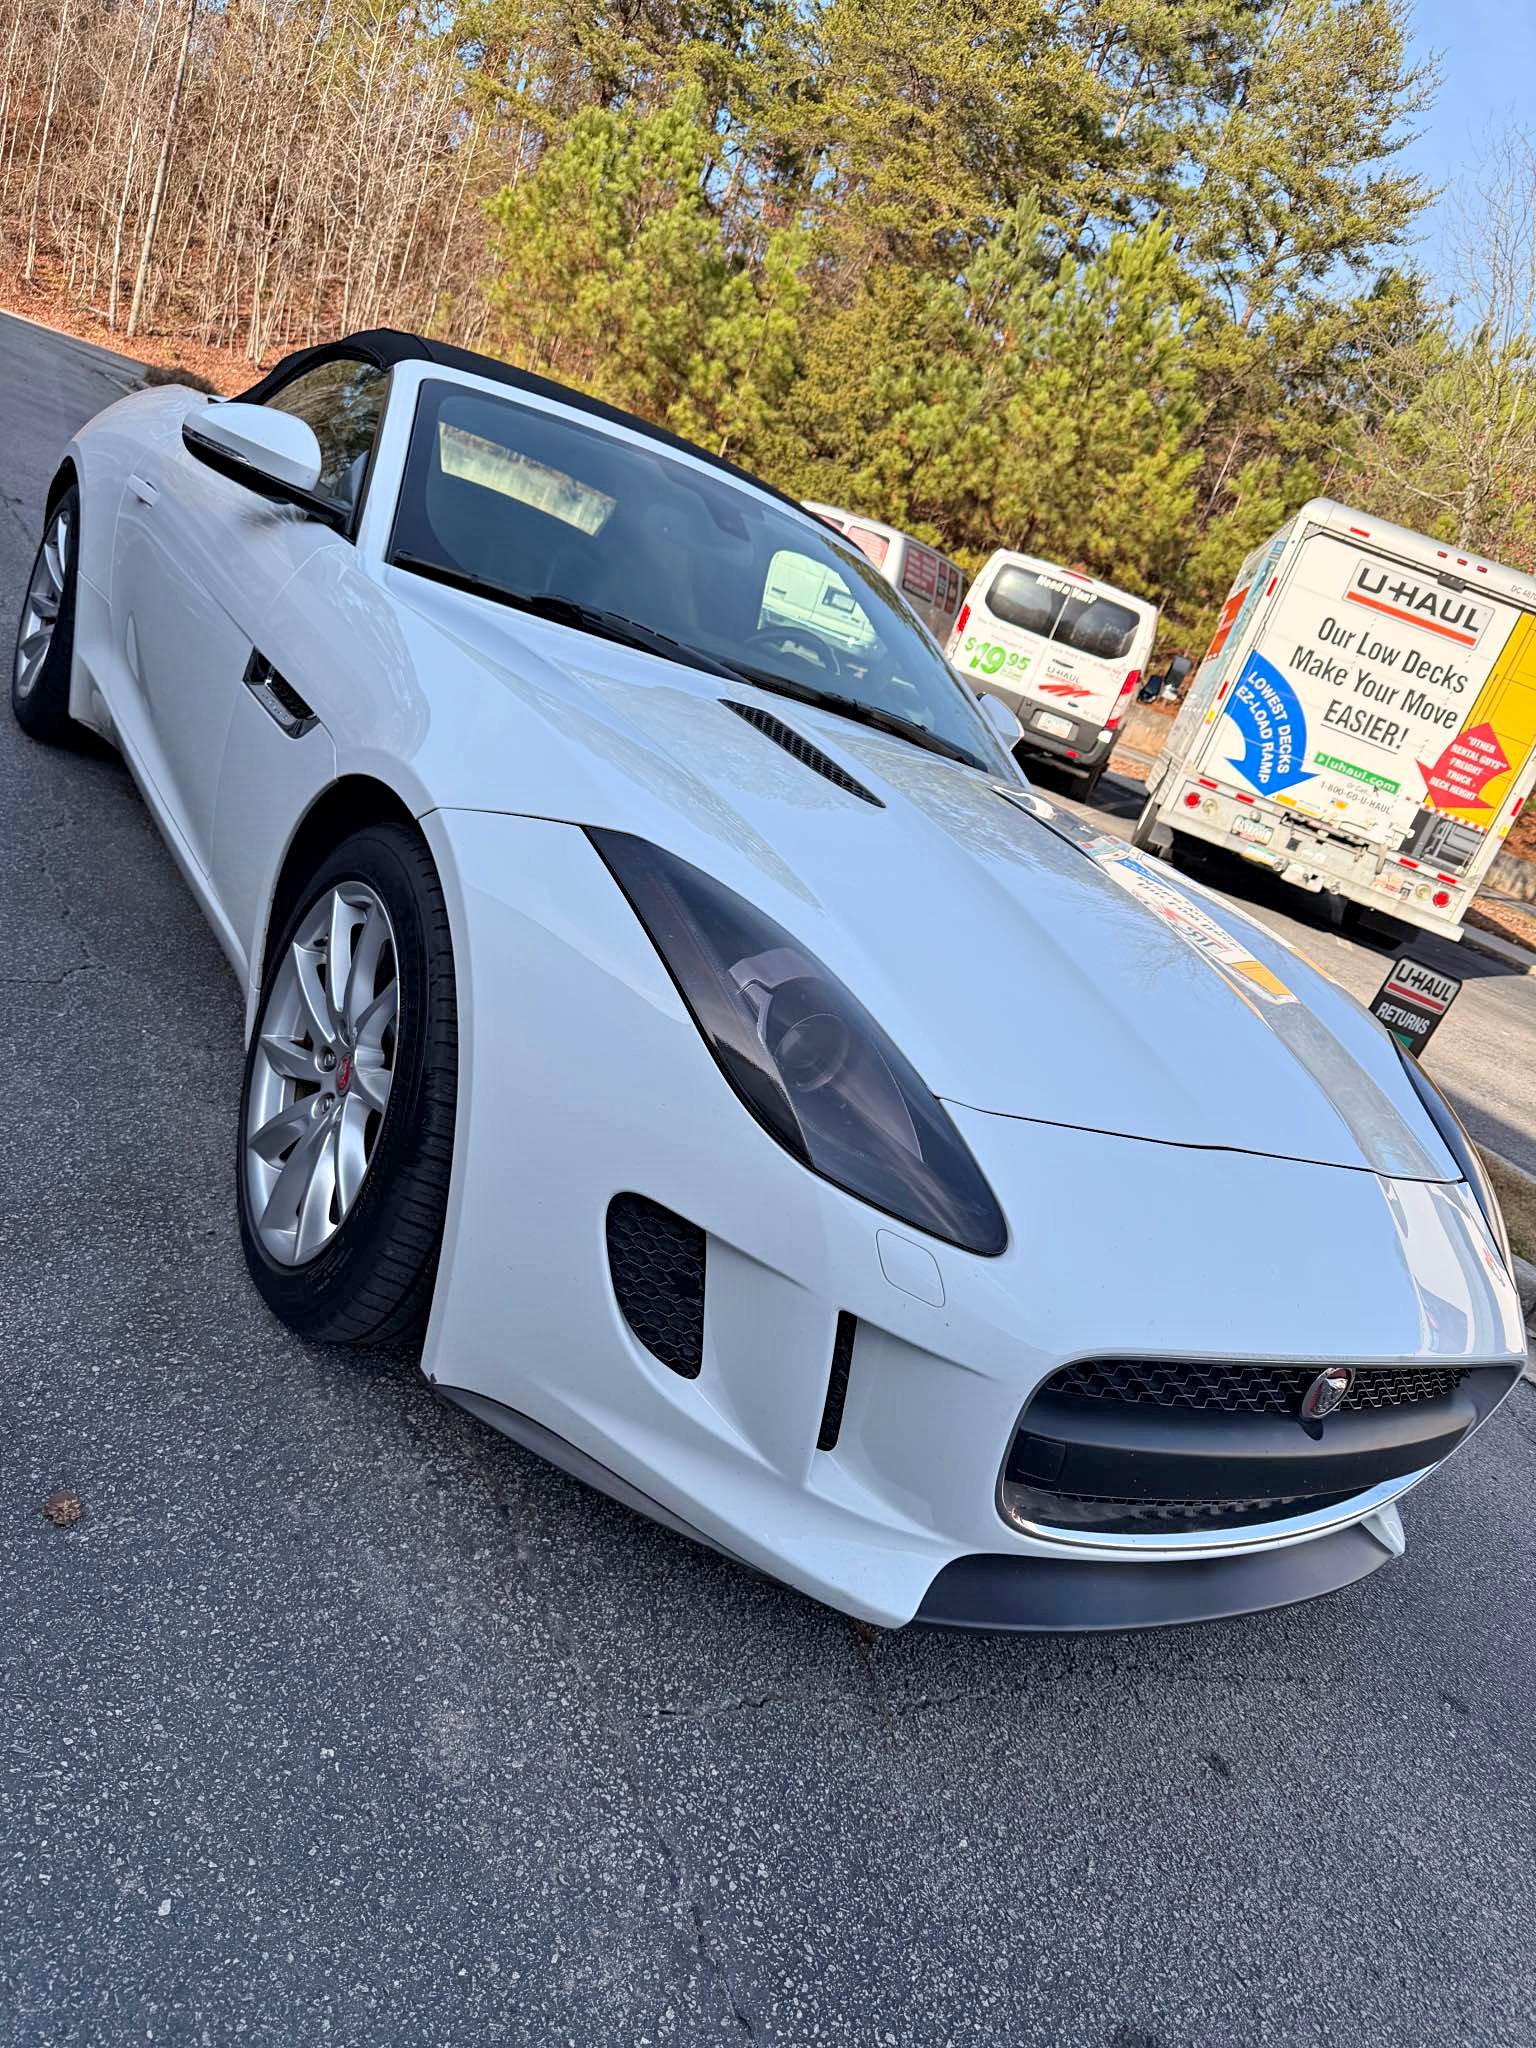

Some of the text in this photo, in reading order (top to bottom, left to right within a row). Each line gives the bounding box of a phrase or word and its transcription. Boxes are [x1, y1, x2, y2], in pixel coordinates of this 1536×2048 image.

[1356, 567, 1480, 633] U-HAUL
[1318, 616, 1469, 694] Our Low Decks
[1289, 645, 1459, 729] Make Your Move
[1235, 685, 1275, 784] EZ-LOAD RAMP
[1248, 671, 1292, 774] LOWEST DECKS
[1323, 699, 1410, 749] EASIER!
[1329, 760, 1396, 793] uhaul.com
[1446, 769, 1473, 785] TRUCK
[1449, 757, 1483, 776] FREIGHT
[1448, 784, 1478, 801] HEIGHT
[1395, 963, 1452, 1002] U-HAUL
[1376, 1001, 1430, 1035] RETURNS
